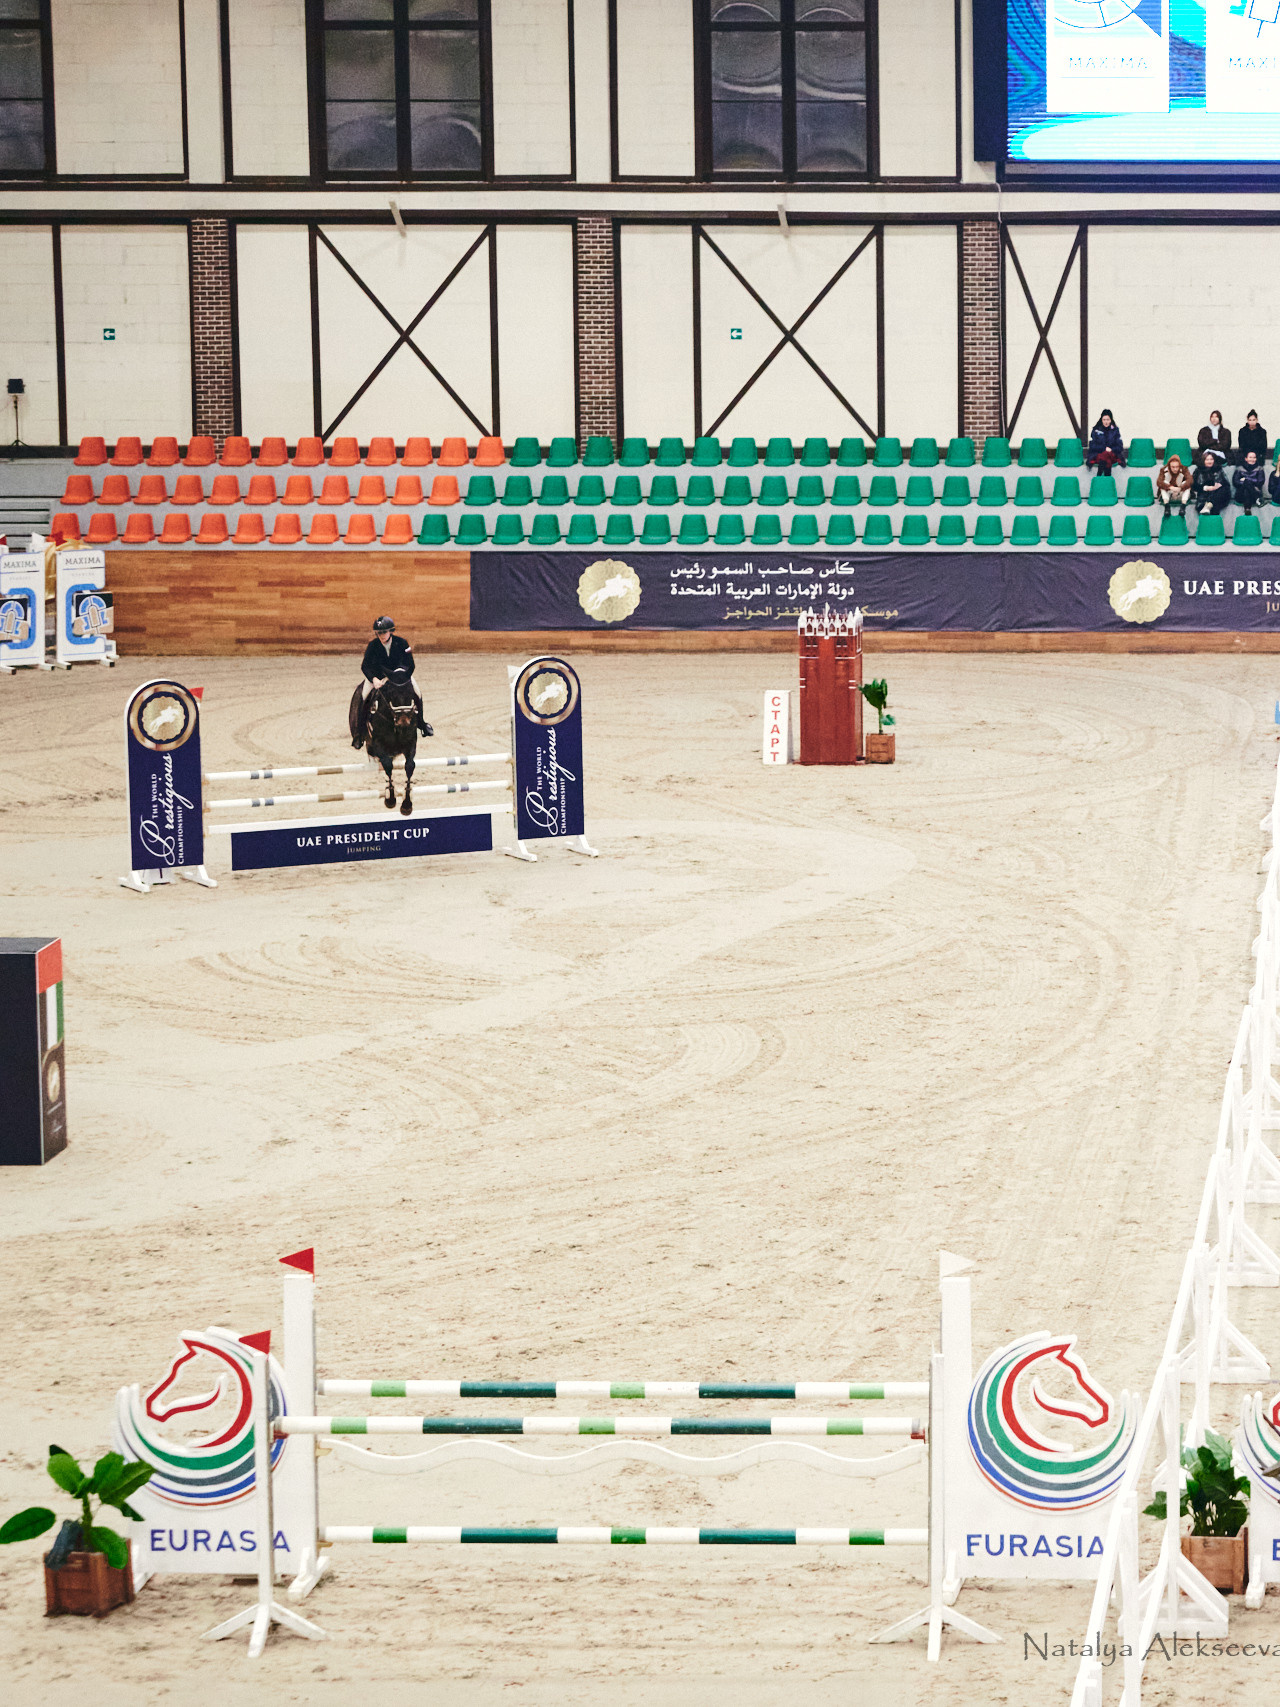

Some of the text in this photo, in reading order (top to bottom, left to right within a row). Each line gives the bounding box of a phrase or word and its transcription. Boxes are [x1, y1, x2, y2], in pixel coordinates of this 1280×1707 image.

[1069, 57, 1149, 69] MAXIMA
[65, 556, 101, 565] MAXIMA
[819, 560, 855, 578] كأس
[670, 562, 706, 579] رئيس
[707, 562, 753, 579] السمو
[670, 583, 721, 596] المتحدة
[725, 582, 770, 600] العربية
[827, 582, 855, 600] دولة
[1183, 580, 1225, 596] UAE
[722, 606, 772, 620] الحواجز
[770, 696, 781, 762] СТАРТ
[525, 726, 576, 836] Prestigious
[140, 752, 194, 866] Prestigious
[296, 827, 430, 848] UAE PRESIDENT CUP
[150, 1529, 291, 1552] EURASA
